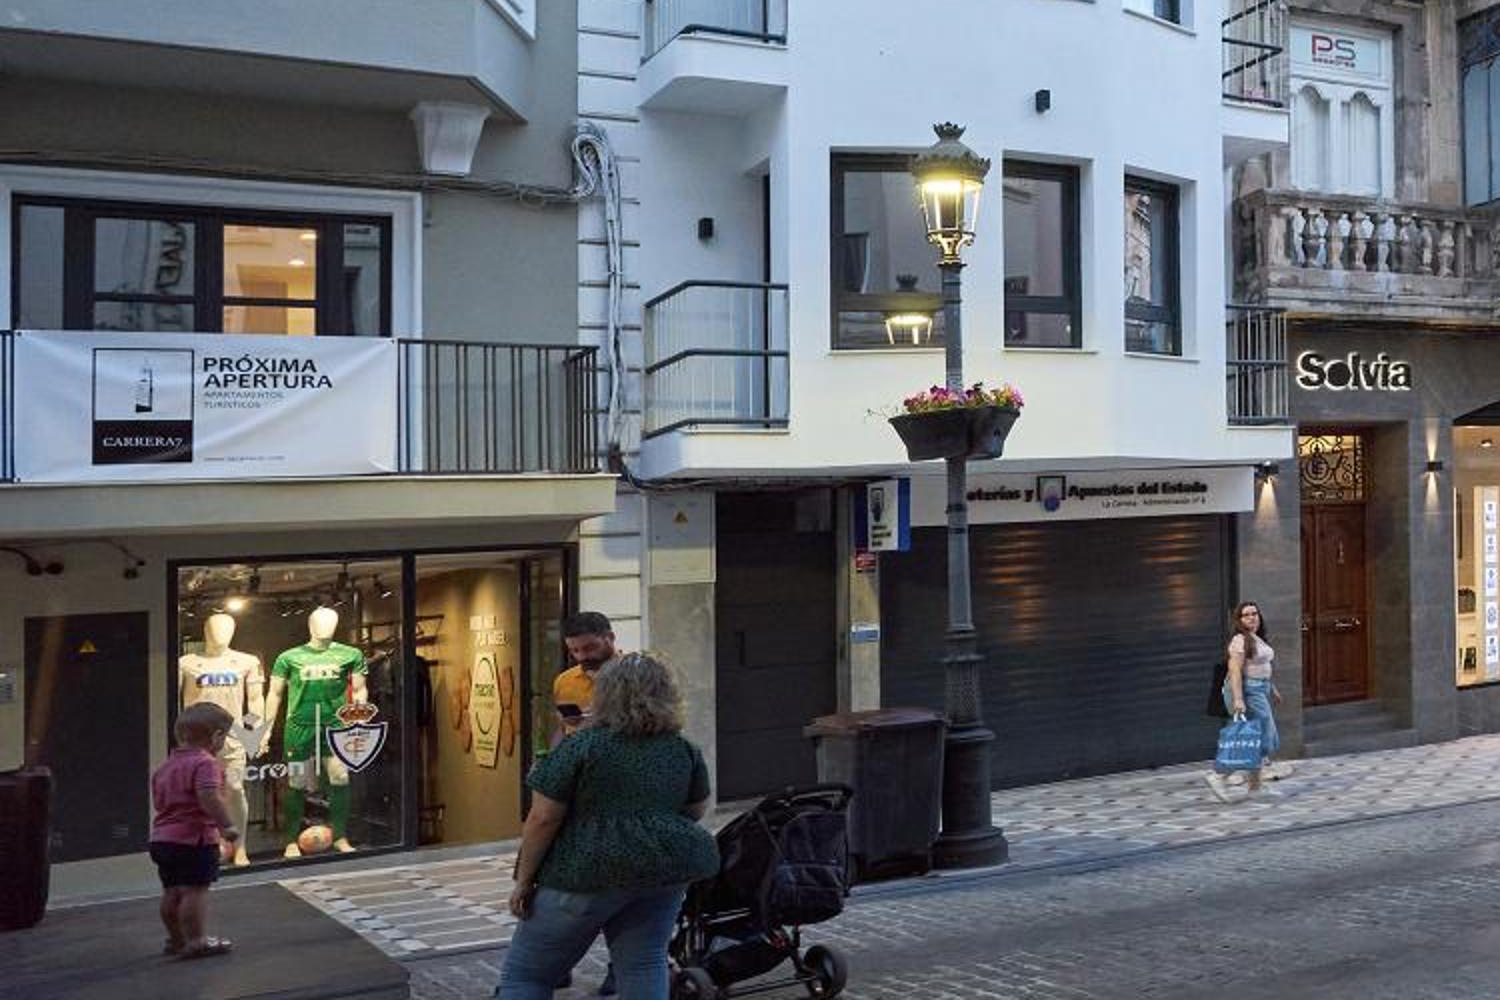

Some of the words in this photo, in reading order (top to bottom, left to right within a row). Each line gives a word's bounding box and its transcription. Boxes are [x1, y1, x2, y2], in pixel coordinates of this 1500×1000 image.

[1311, 34, 1356, 61] PS
[203, 353, 318, 373] PRÓXIMA
[1296, 350, 1412, 391] Solvia
[203, 373, 333, 389] APERTURA
[102, 436, 184, 448] CARRERA7
[966, 484, 1021, 501] oterías
[1023, 489, 1035, 503] y
[1068, 482, 1135, 500] Apuestas
[1137, 481, 1160, 495] del
[1162, 480, 1208, 494] Estado
